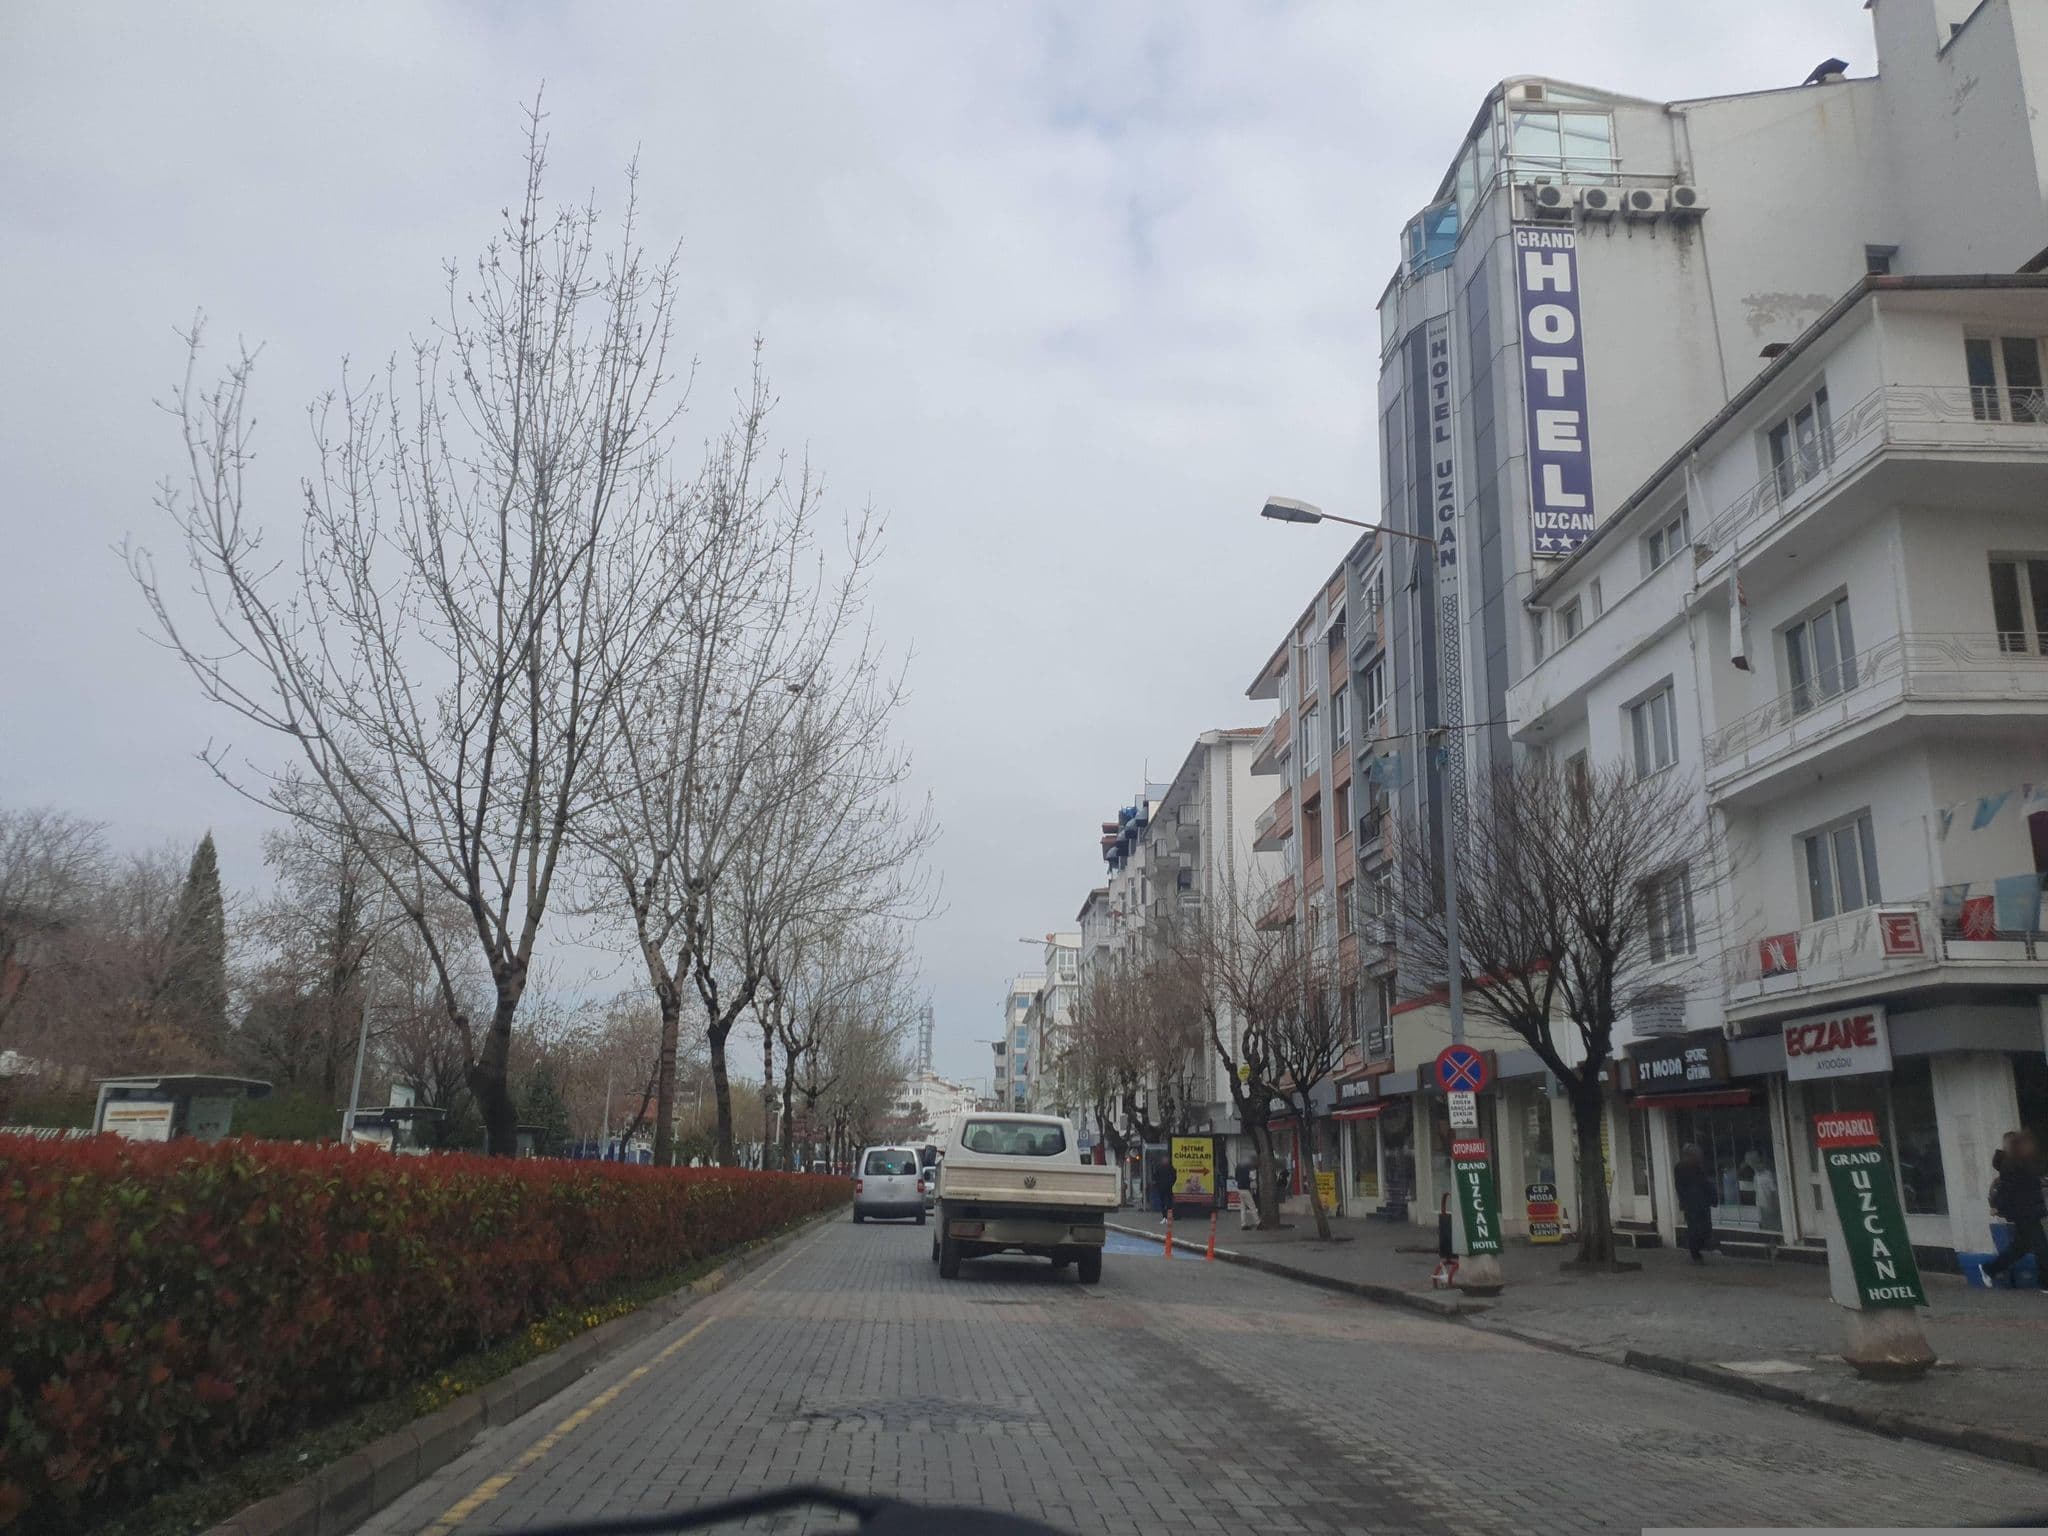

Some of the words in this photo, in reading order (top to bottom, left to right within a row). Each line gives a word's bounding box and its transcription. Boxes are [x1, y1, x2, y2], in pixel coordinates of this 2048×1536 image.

[1517, 231, 1575, 249] GRAND
[1525, 251, 1586, 507] HOTEL
[1431, 339, 1451, 444] HOTEL
[1436, 459, 1456, 568] UZCAN
[1534, 511, 1594, 531] UZCAN
[1785, 1013, 1878, 1057] ECZANE
[1639, 1062, 1650, 1080] ST
[1652, 1057, 1682, 1078] MODA
[1817, 1118, 1874, 1138] OTOPARKLI
[1453, 1142, 1486, 1155] OTOPARKLI
[1457, 1162, 1486, 1170] GRAND
[1830, 1152, 1881, 1166] GRAND
[1532, 1185, 1549, 1193] CEP
[1469, 1173, 1489, 1238] UZCAN
[1850, 1170, 1897, 1280] UZCAN
[1472, 1241, 1498, 1250] HOTEL
[1869, 1286, 1917, 1300] HOTEL
